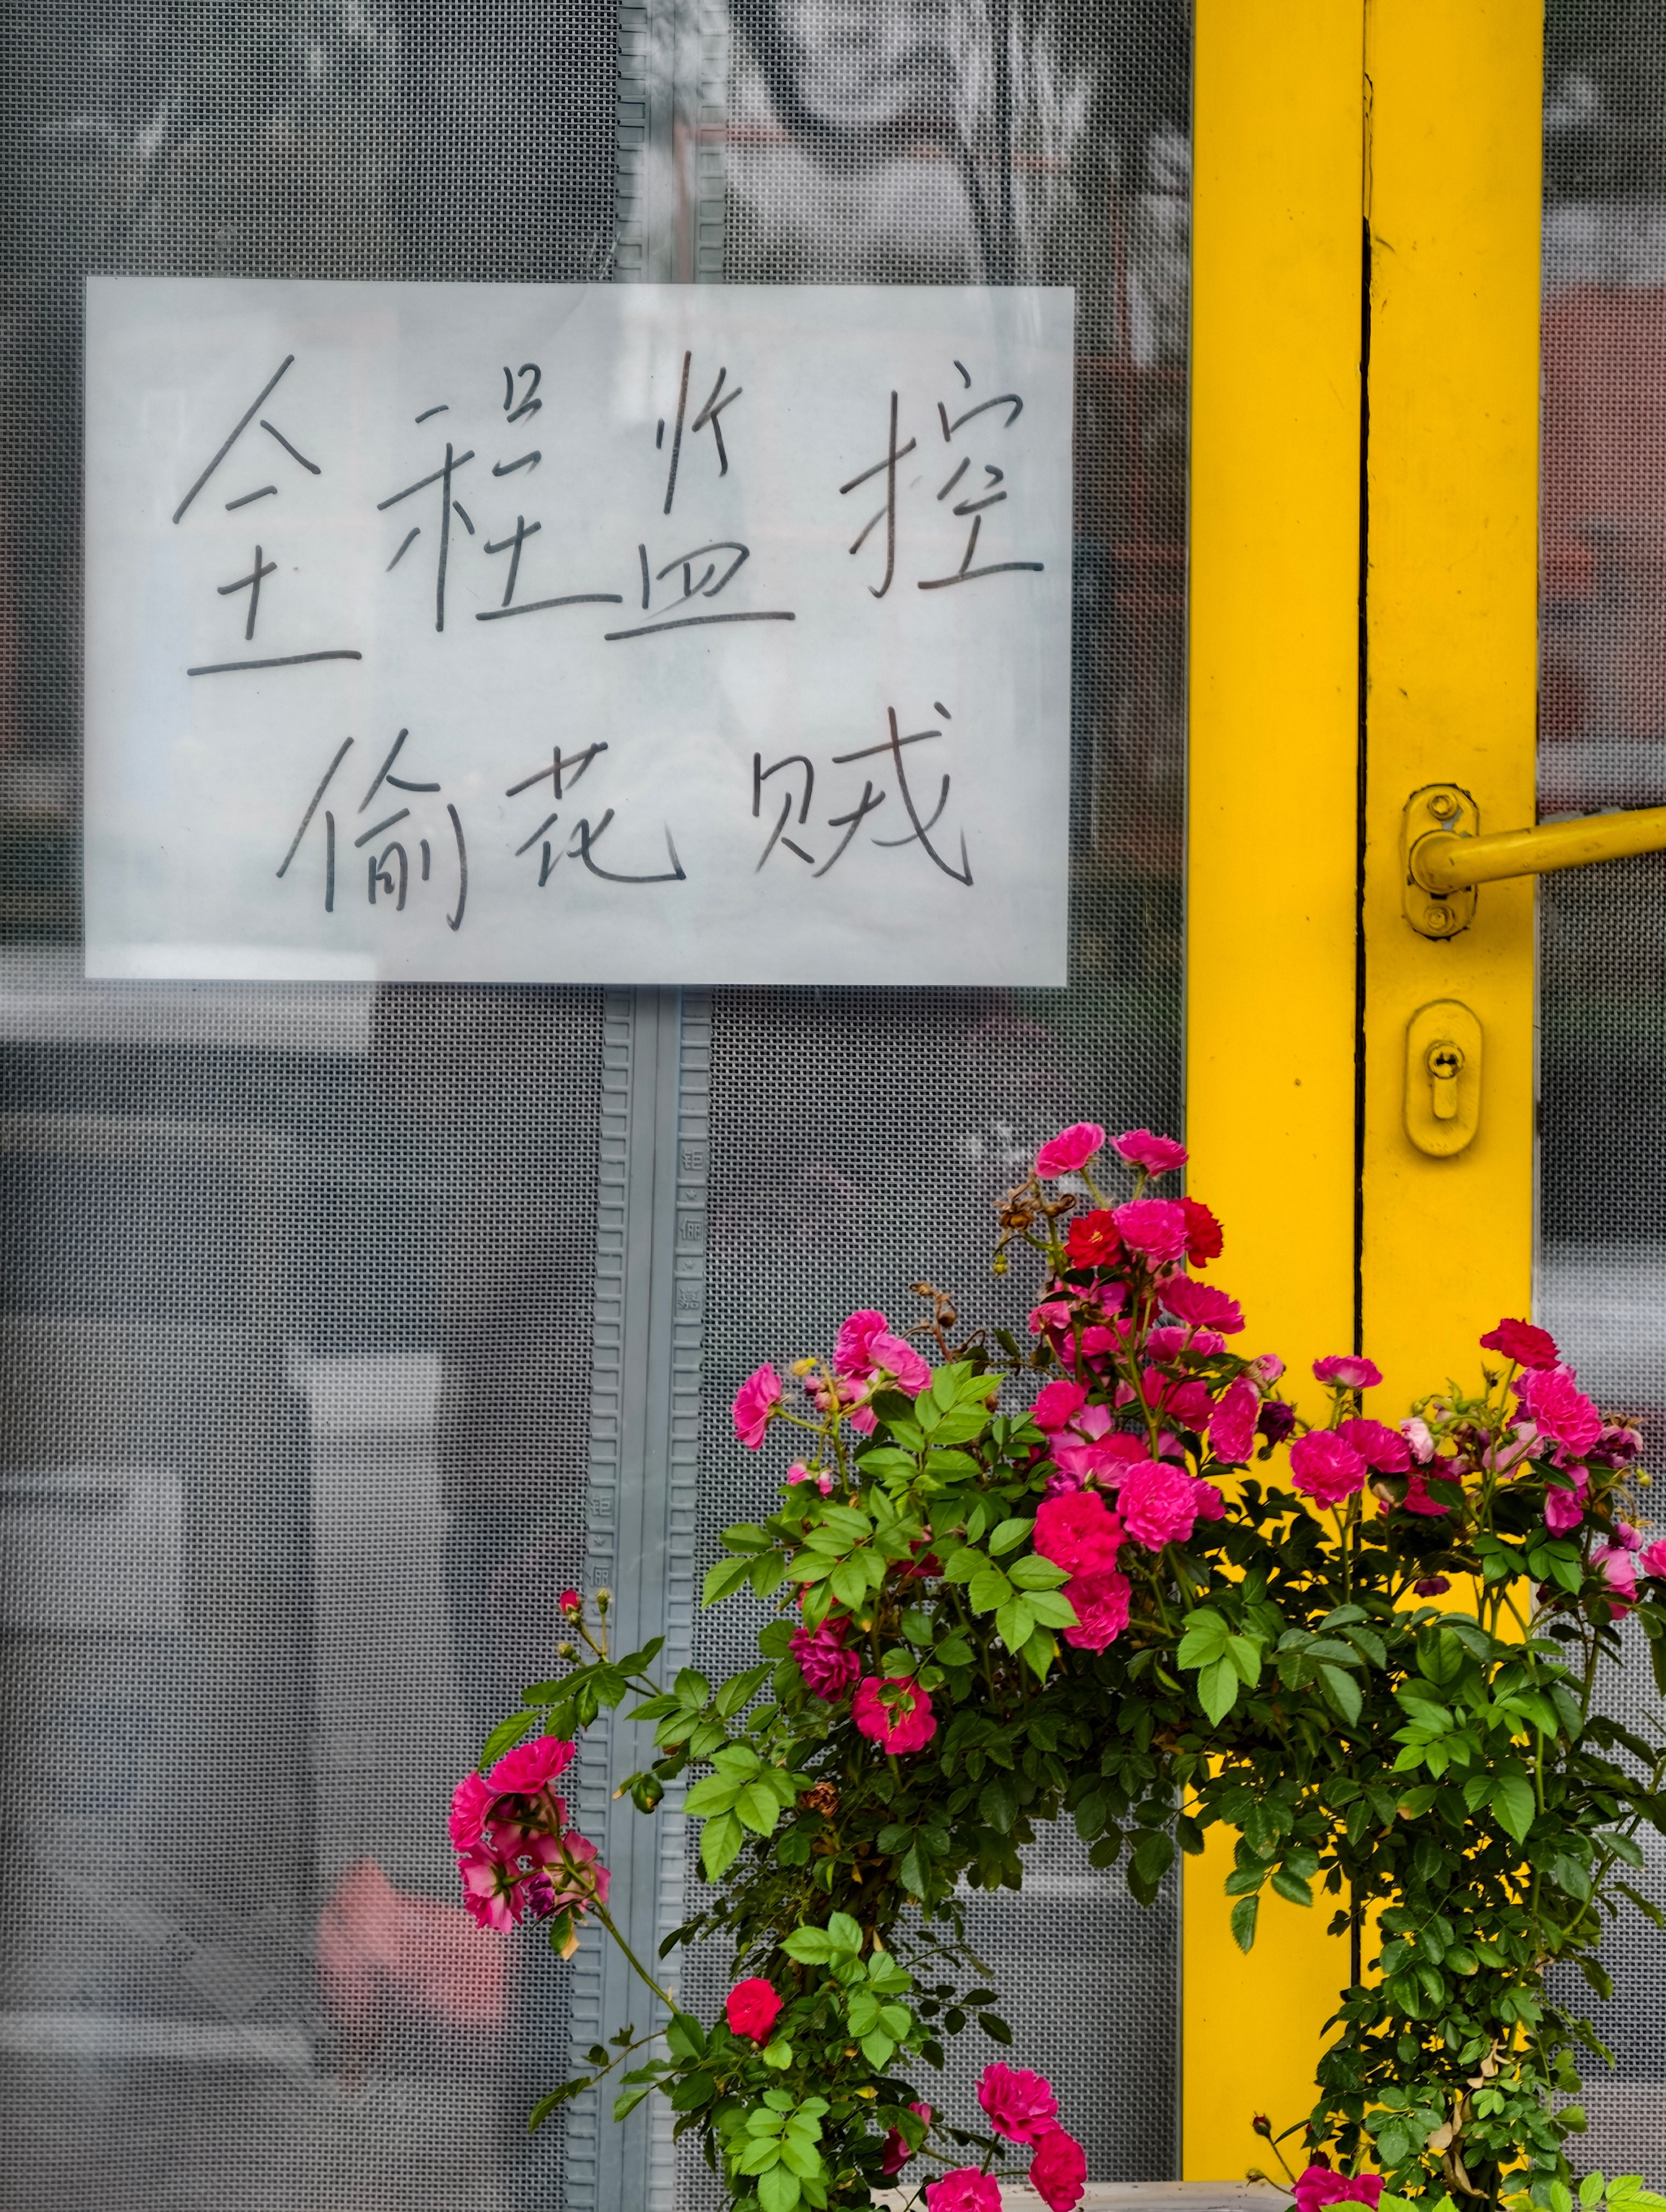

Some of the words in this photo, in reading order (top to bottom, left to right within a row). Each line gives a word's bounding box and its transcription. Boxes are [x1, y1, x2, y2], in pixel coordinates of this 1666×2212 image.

[172, 350, 1045, 677] 全程监控
[275, 702, 975, 932] 偷花贼
